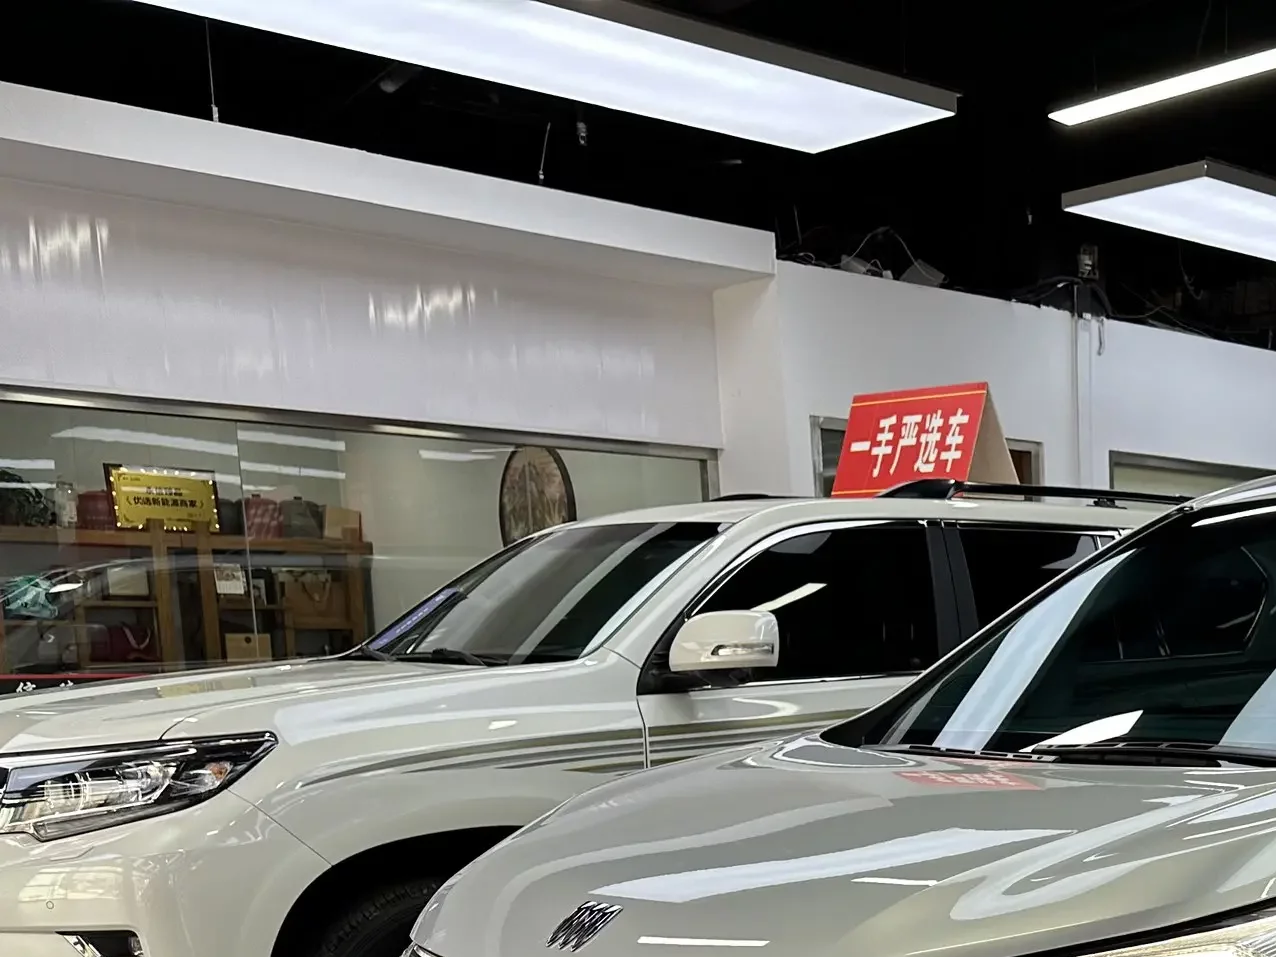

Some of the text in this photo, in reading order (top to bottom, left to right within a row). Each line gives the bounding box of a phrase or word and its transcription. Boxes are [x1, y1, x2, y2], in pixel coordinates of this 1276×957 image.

[849, 407, 970, 479] 一手严选车
